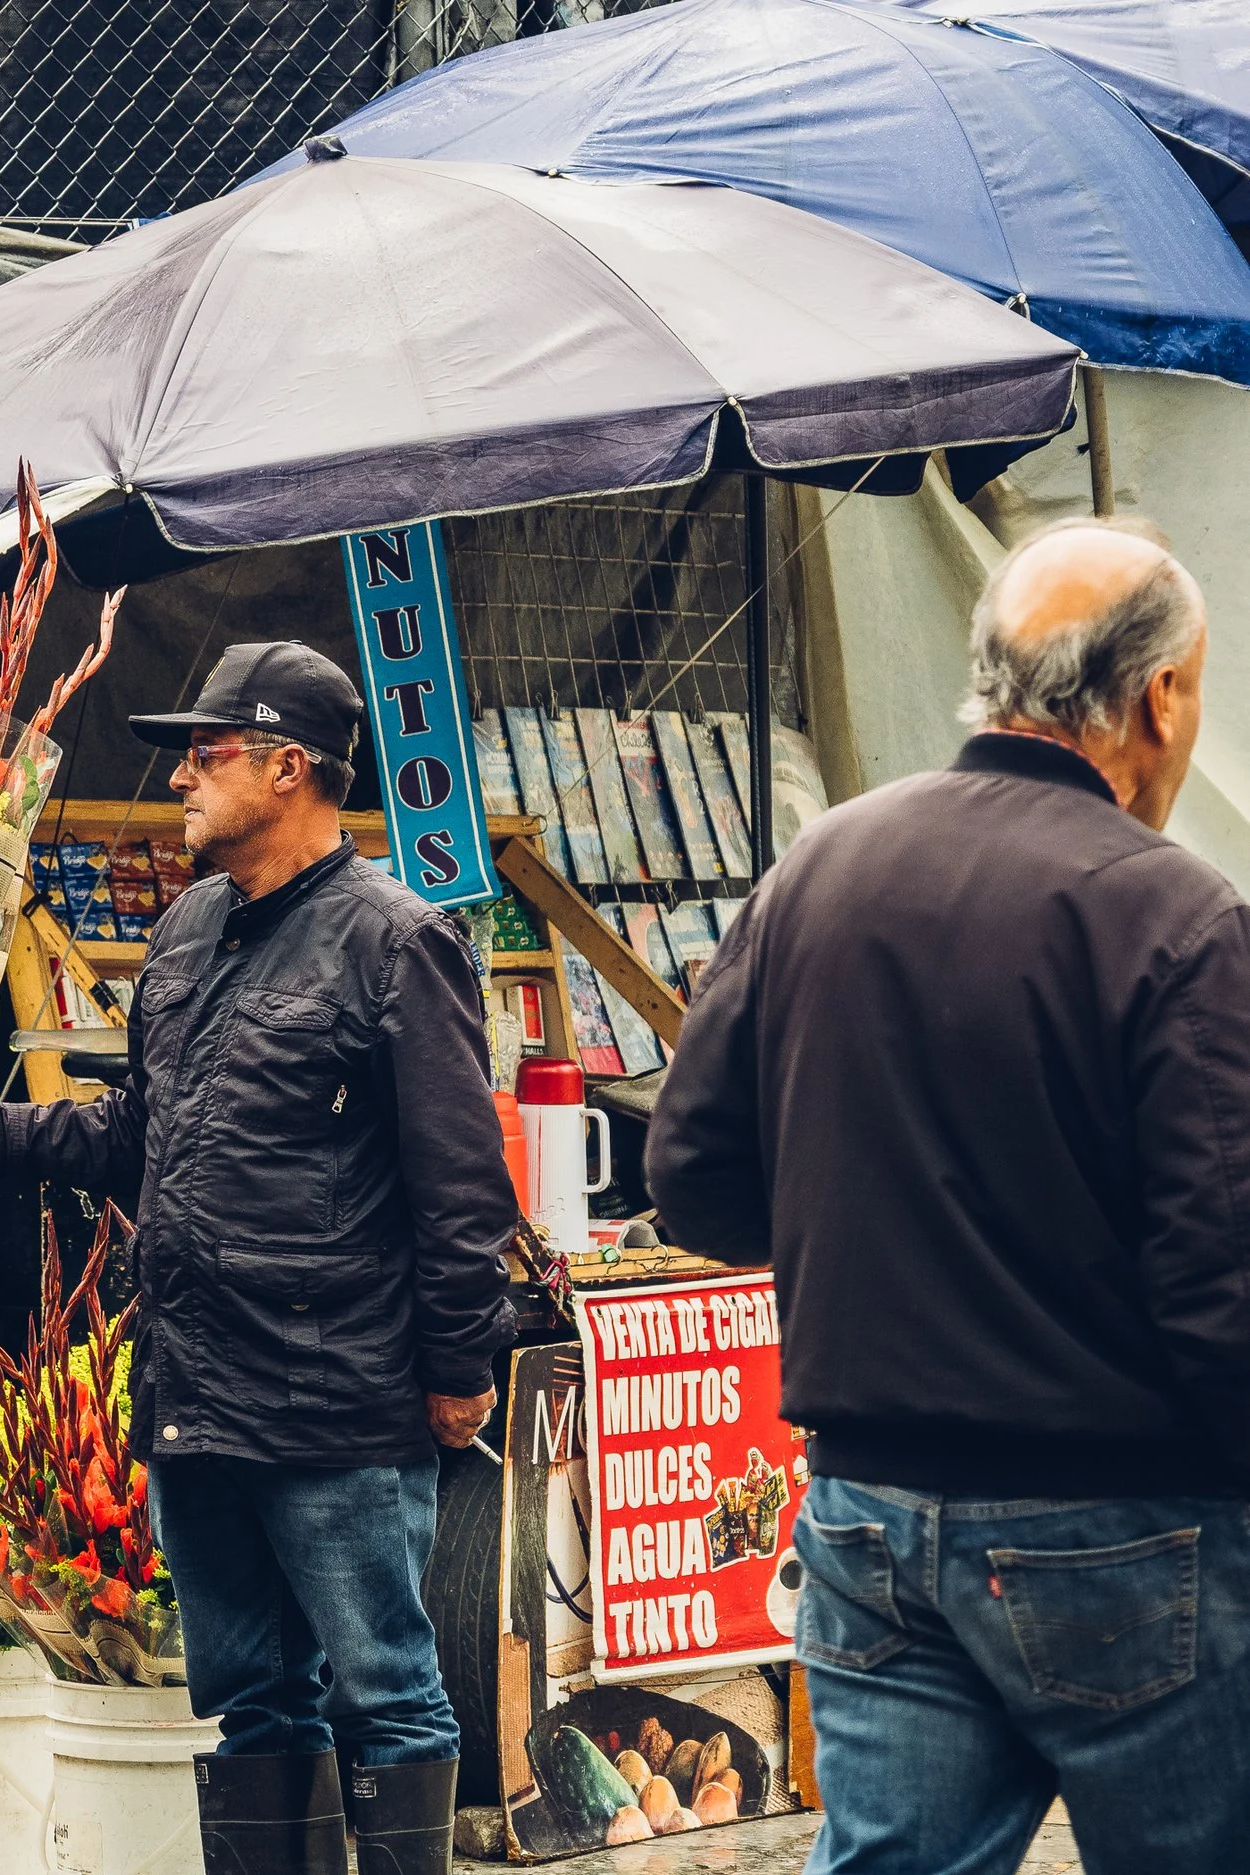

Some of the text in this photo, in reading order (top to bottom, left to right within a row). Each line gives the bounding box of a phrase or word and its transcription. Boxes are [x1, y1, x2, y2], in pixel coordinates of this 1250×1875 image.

[590, 1300, 676, 1361] VENTA
[672, 1297, 710, 1354] DE
[532, 1385, 587, 1465] M
[602, 1365, 741, 1436] MINUTOS
[605, 1441, 713, 1511] DULCES
[607, 1518, 707, 1587] AGUA
[609, 1590, 719, 1659] TINTO
